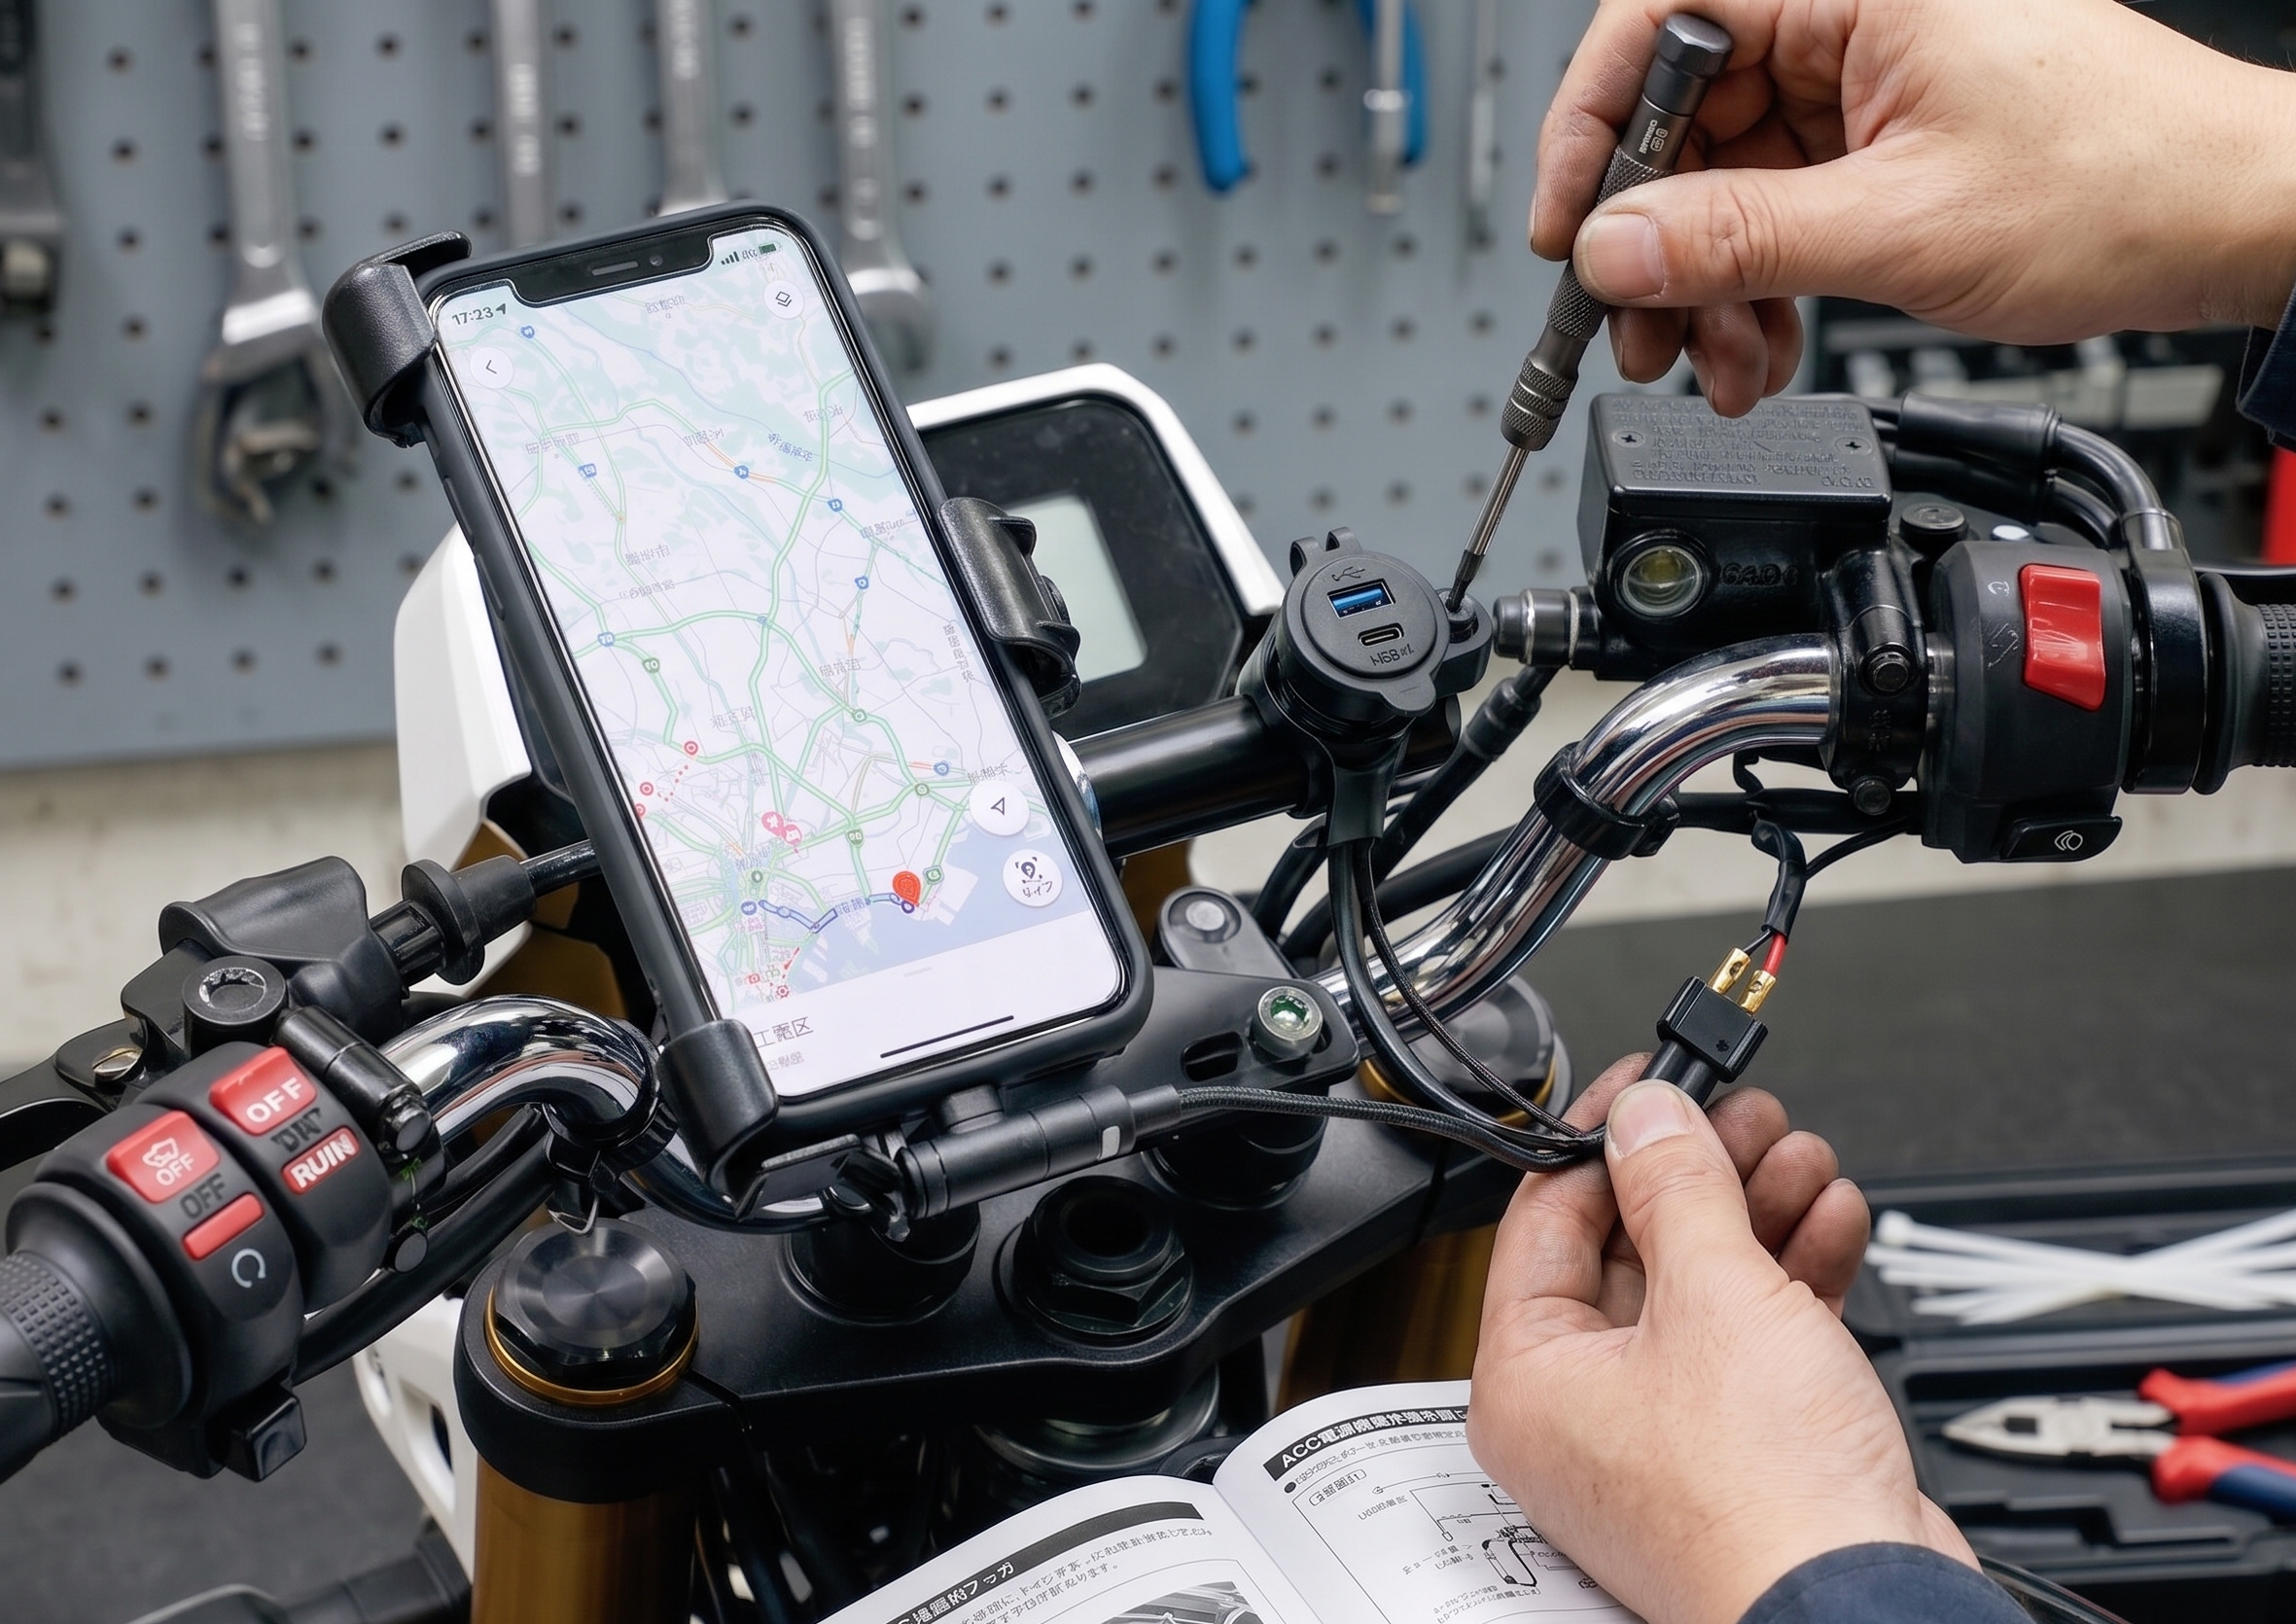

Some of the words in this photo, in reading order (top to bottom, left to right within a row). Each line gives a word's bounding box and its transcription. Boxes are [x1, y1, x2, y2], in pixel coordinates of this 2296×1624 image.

[452, 306, 493, 325] 17:23
[246, 1077, 302, 1122] OFF
[156, 1152, 194, 1185] OFF
[179, 1173, 227, 1218] OFF
